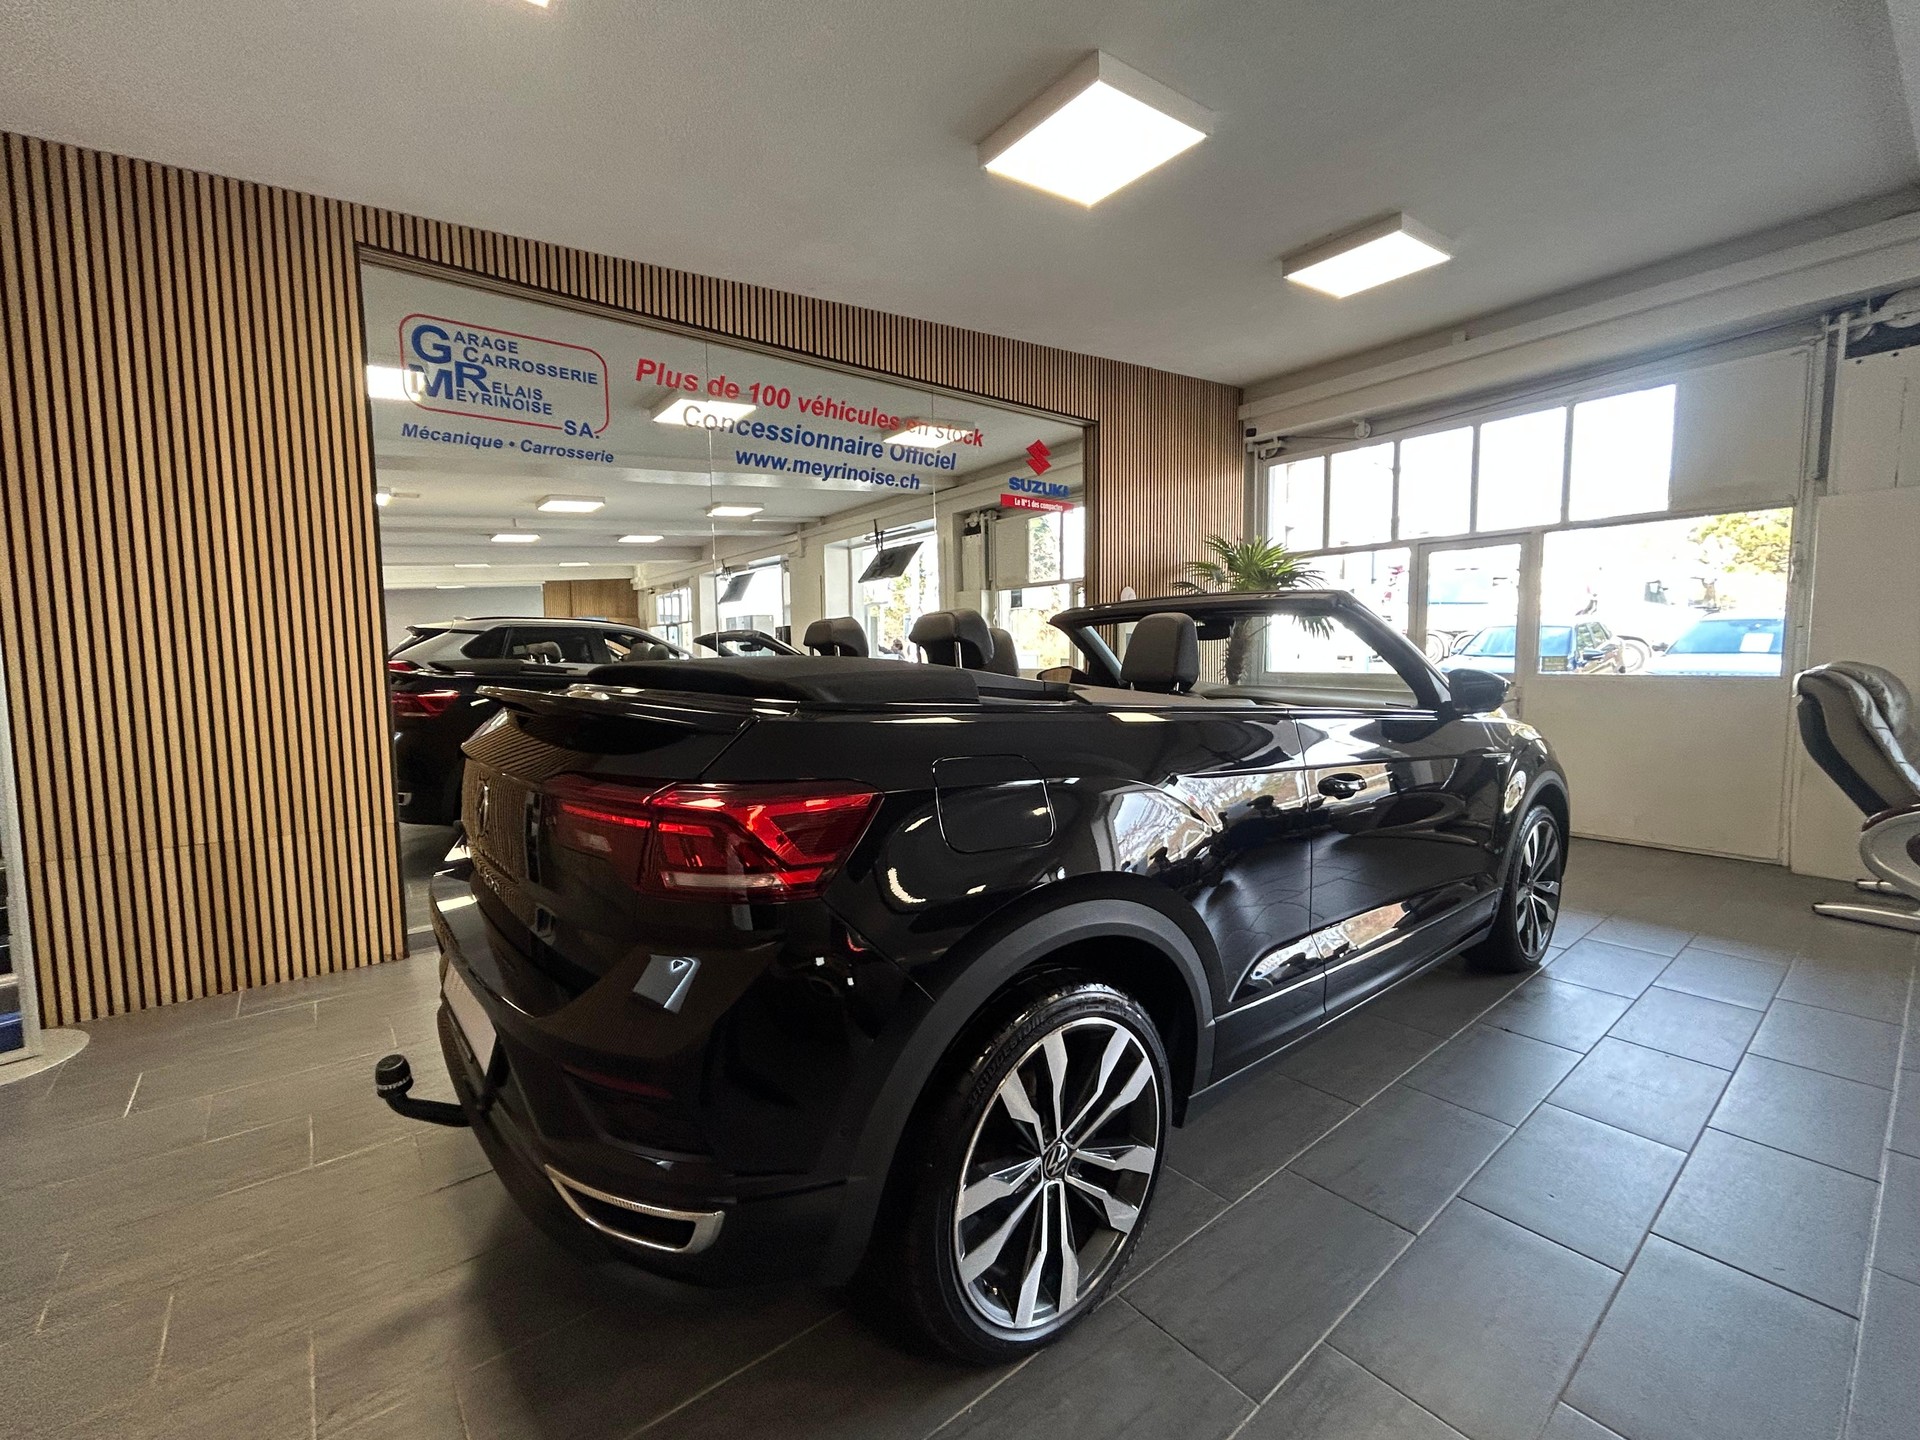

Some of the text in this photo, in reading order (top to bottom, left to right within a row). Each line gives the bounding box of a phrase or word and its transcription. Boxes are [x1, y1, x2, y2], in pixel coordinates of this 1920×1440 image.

[463, 346, 598, 385] CARROSSERIE
[636, 358, 983, 447] Plus de 100 véhicules en stock
[402, 423, 615, 463] Mécanique Carrosserie
[683, 405, 957, 470] Concessionnaire Officiel
[735, 449, 920, 489] www.meyrinoise.ch
[1008, 476, 1070, 498] SUZUKI
